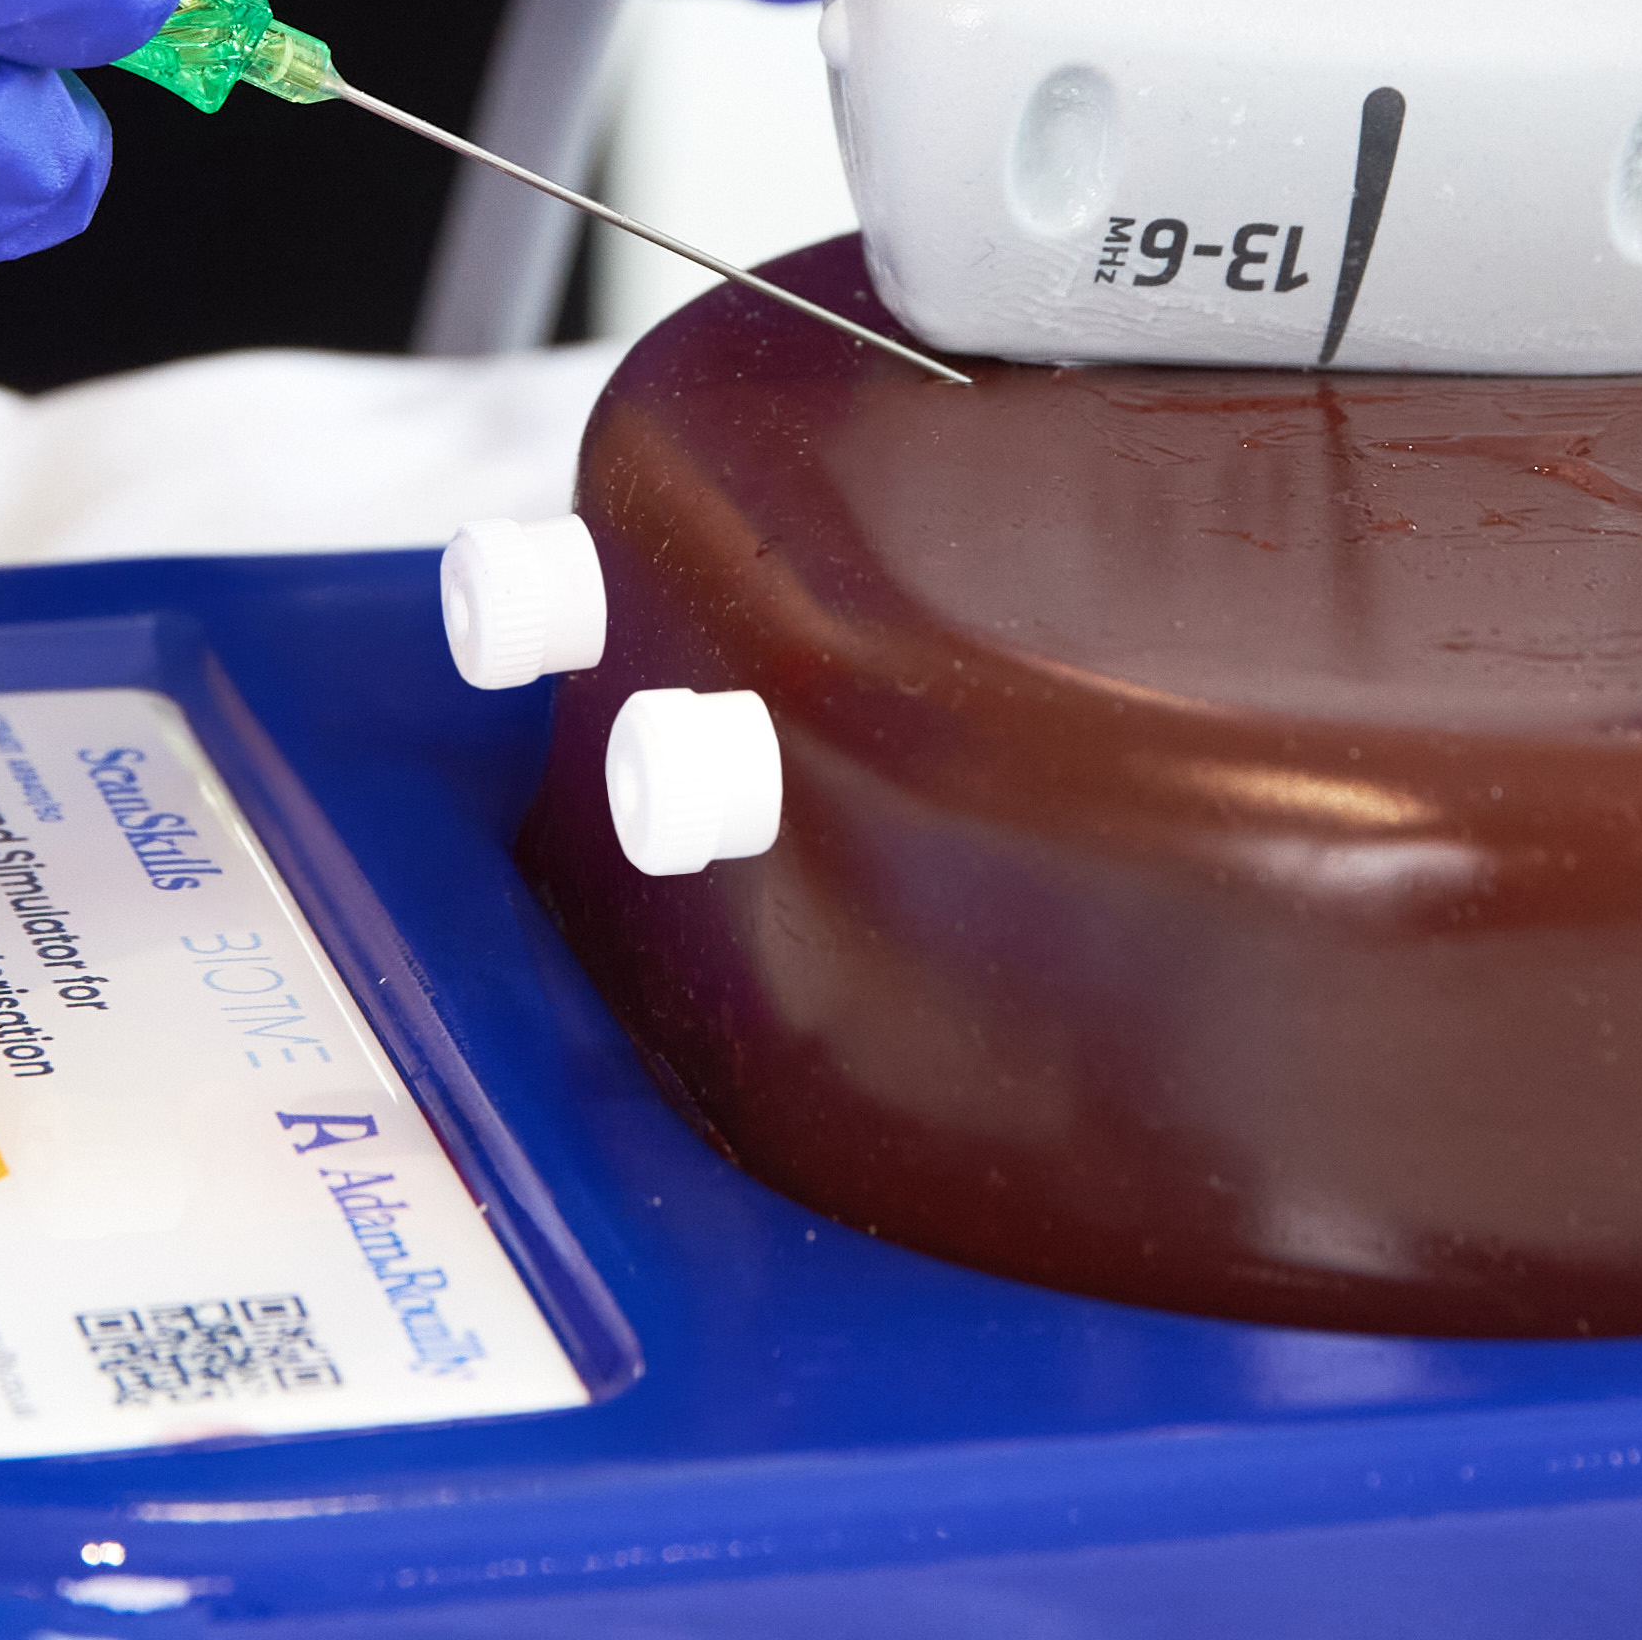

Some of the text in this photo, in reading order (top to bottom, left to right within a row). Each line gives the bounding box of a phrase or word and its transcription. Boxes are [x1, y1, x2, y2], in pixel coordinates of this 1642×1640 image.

[1094, 216, 1136, 284] MHz
[1133, 218, 1309, 293] 13-6
[78, 747, 222, 890] ScanSkills
[53, 975, 109, 1010] for
